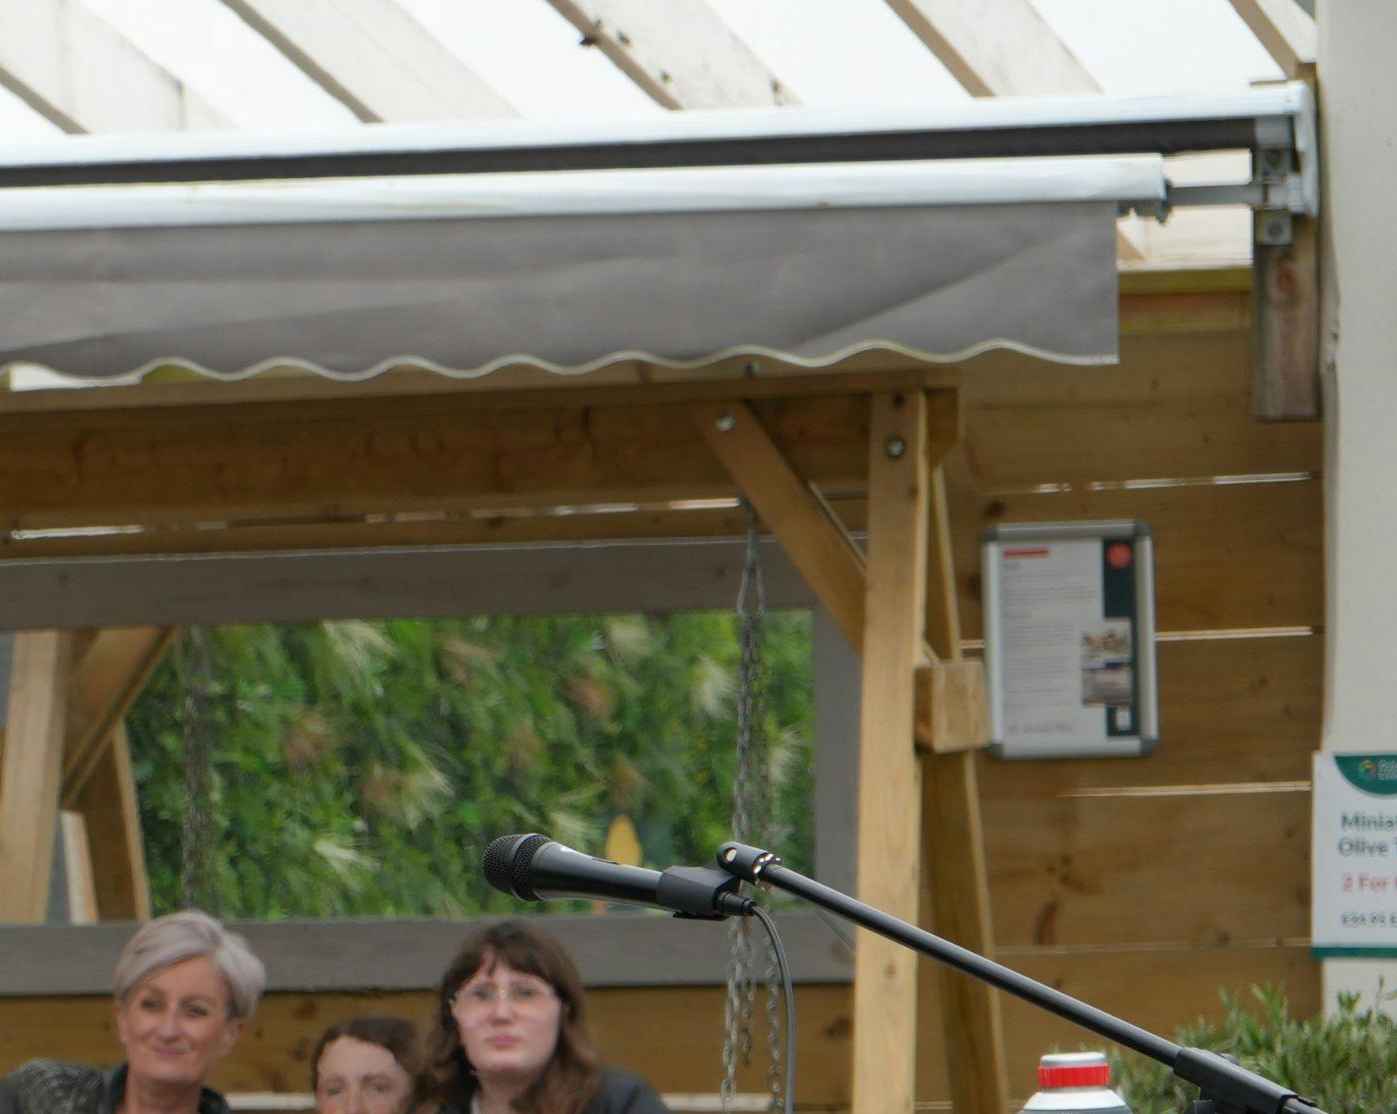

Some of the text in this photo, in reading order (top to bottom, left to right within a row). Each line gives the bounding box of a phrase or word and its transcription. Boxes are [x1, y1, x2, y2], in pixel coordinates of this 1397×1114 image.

[1338, 836, 1389, 856] Olive
[1342, 872, 1390, 892] 2 For
